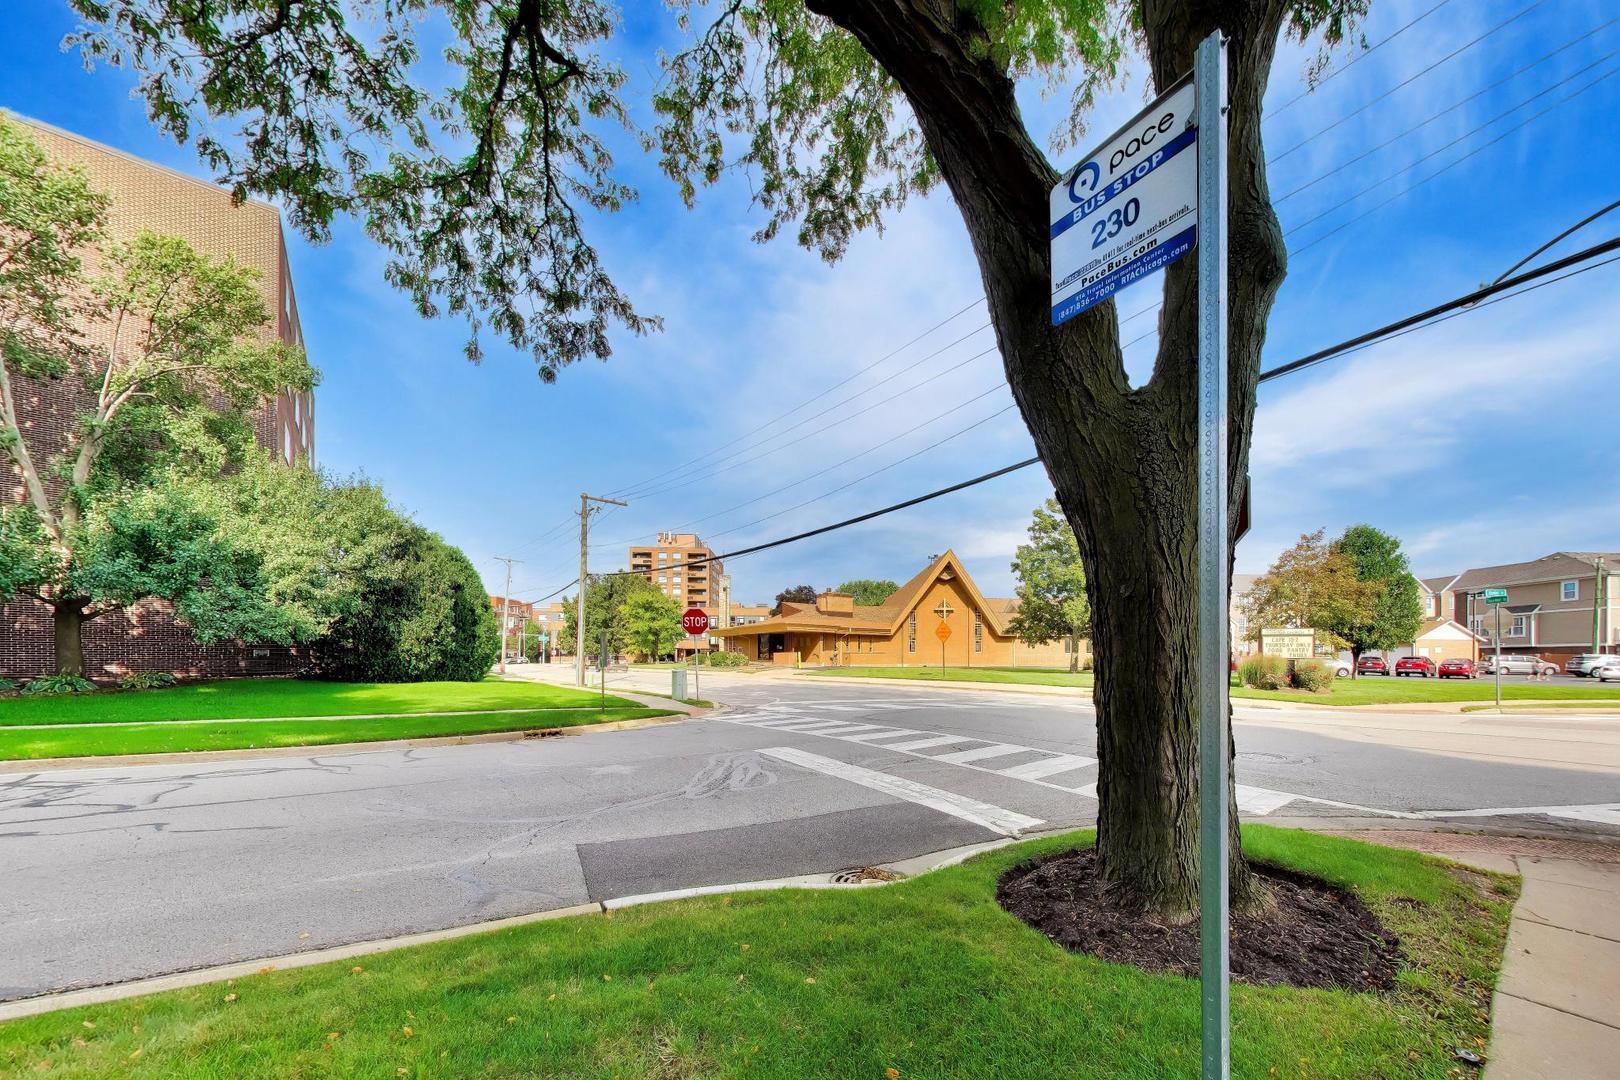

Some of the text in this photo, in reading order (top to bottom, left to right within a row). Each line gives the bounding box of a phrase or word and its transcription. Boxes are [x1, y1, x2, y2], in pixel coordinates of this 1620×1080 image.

[1110, 112, 1174, 175] pace
[1073, 150, 1164, 222] BUS STOP
[1091, 197, 1140, 250] 230
[1081, 238, 1158, 288] PaceBus.com
[1086, 281, 1104, 297] Travel
[1105, 262, 1141, 285] Information
[1143, 247, 1165, 263] Center
[1121, 243, 1188, 285] RTAChicago.com
[684, 616, 707, 628] STOP
